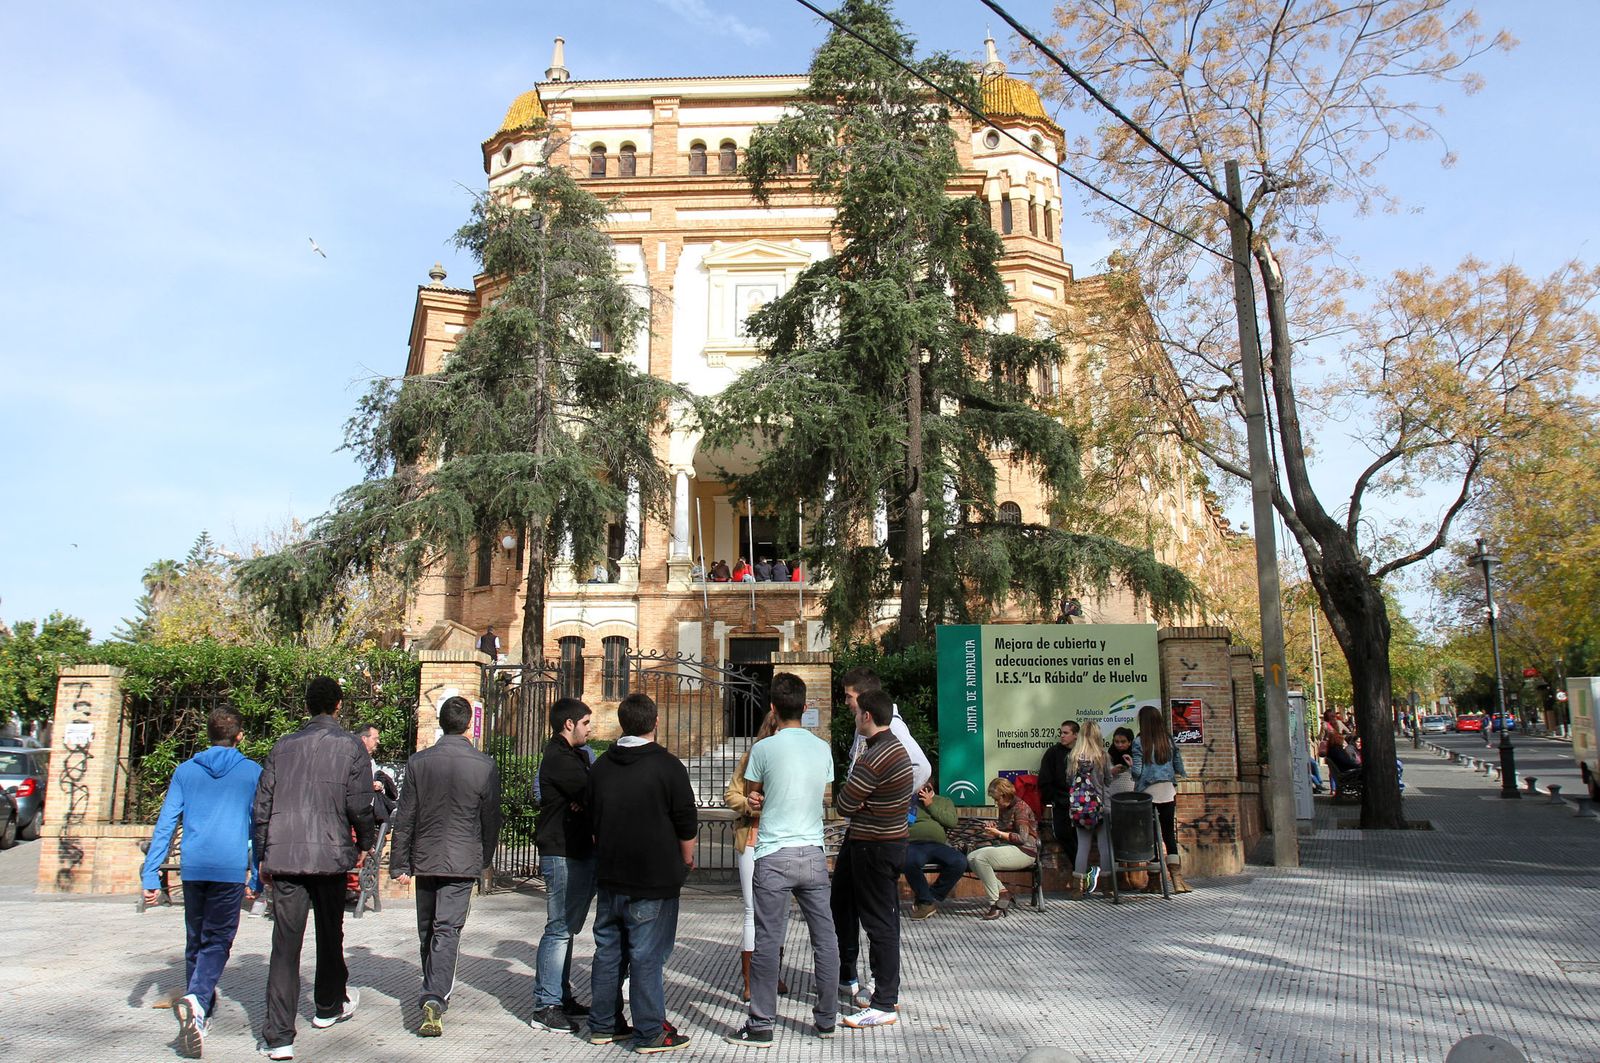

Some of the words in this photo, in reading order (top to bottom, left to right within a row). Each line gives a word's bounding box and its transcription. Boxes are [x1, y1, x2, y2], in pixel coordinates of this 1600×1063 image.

[994, 638, 1033, 652] Mejora
[1036, 637, 1050, 648] de
[1053, 637, 1097, 649] cubierta
[1100, 640, 1107, 652] y
[966, 640, 976, 686] ANDALUCIA
[995, 654, 1068, 666] adecuaciones
[1071, 655, 1105, 666] varias
[1108, 657, 1122, 666] en
[1124, 654, 1134, 666] el
[1093, 670, 1106, 682] de
[1110, 670, 1148, 682] Huelva
[966, 690, 976, 702] DE
[966, 706, 977, 733] JUNTA
[1114, 716, 1134, 724] Europa
[996, 728, 1028, 738] Inversión
[1030, 728, 1062, 738] 58.229,3
[998, 740, 1054, 749] Infraestructura
